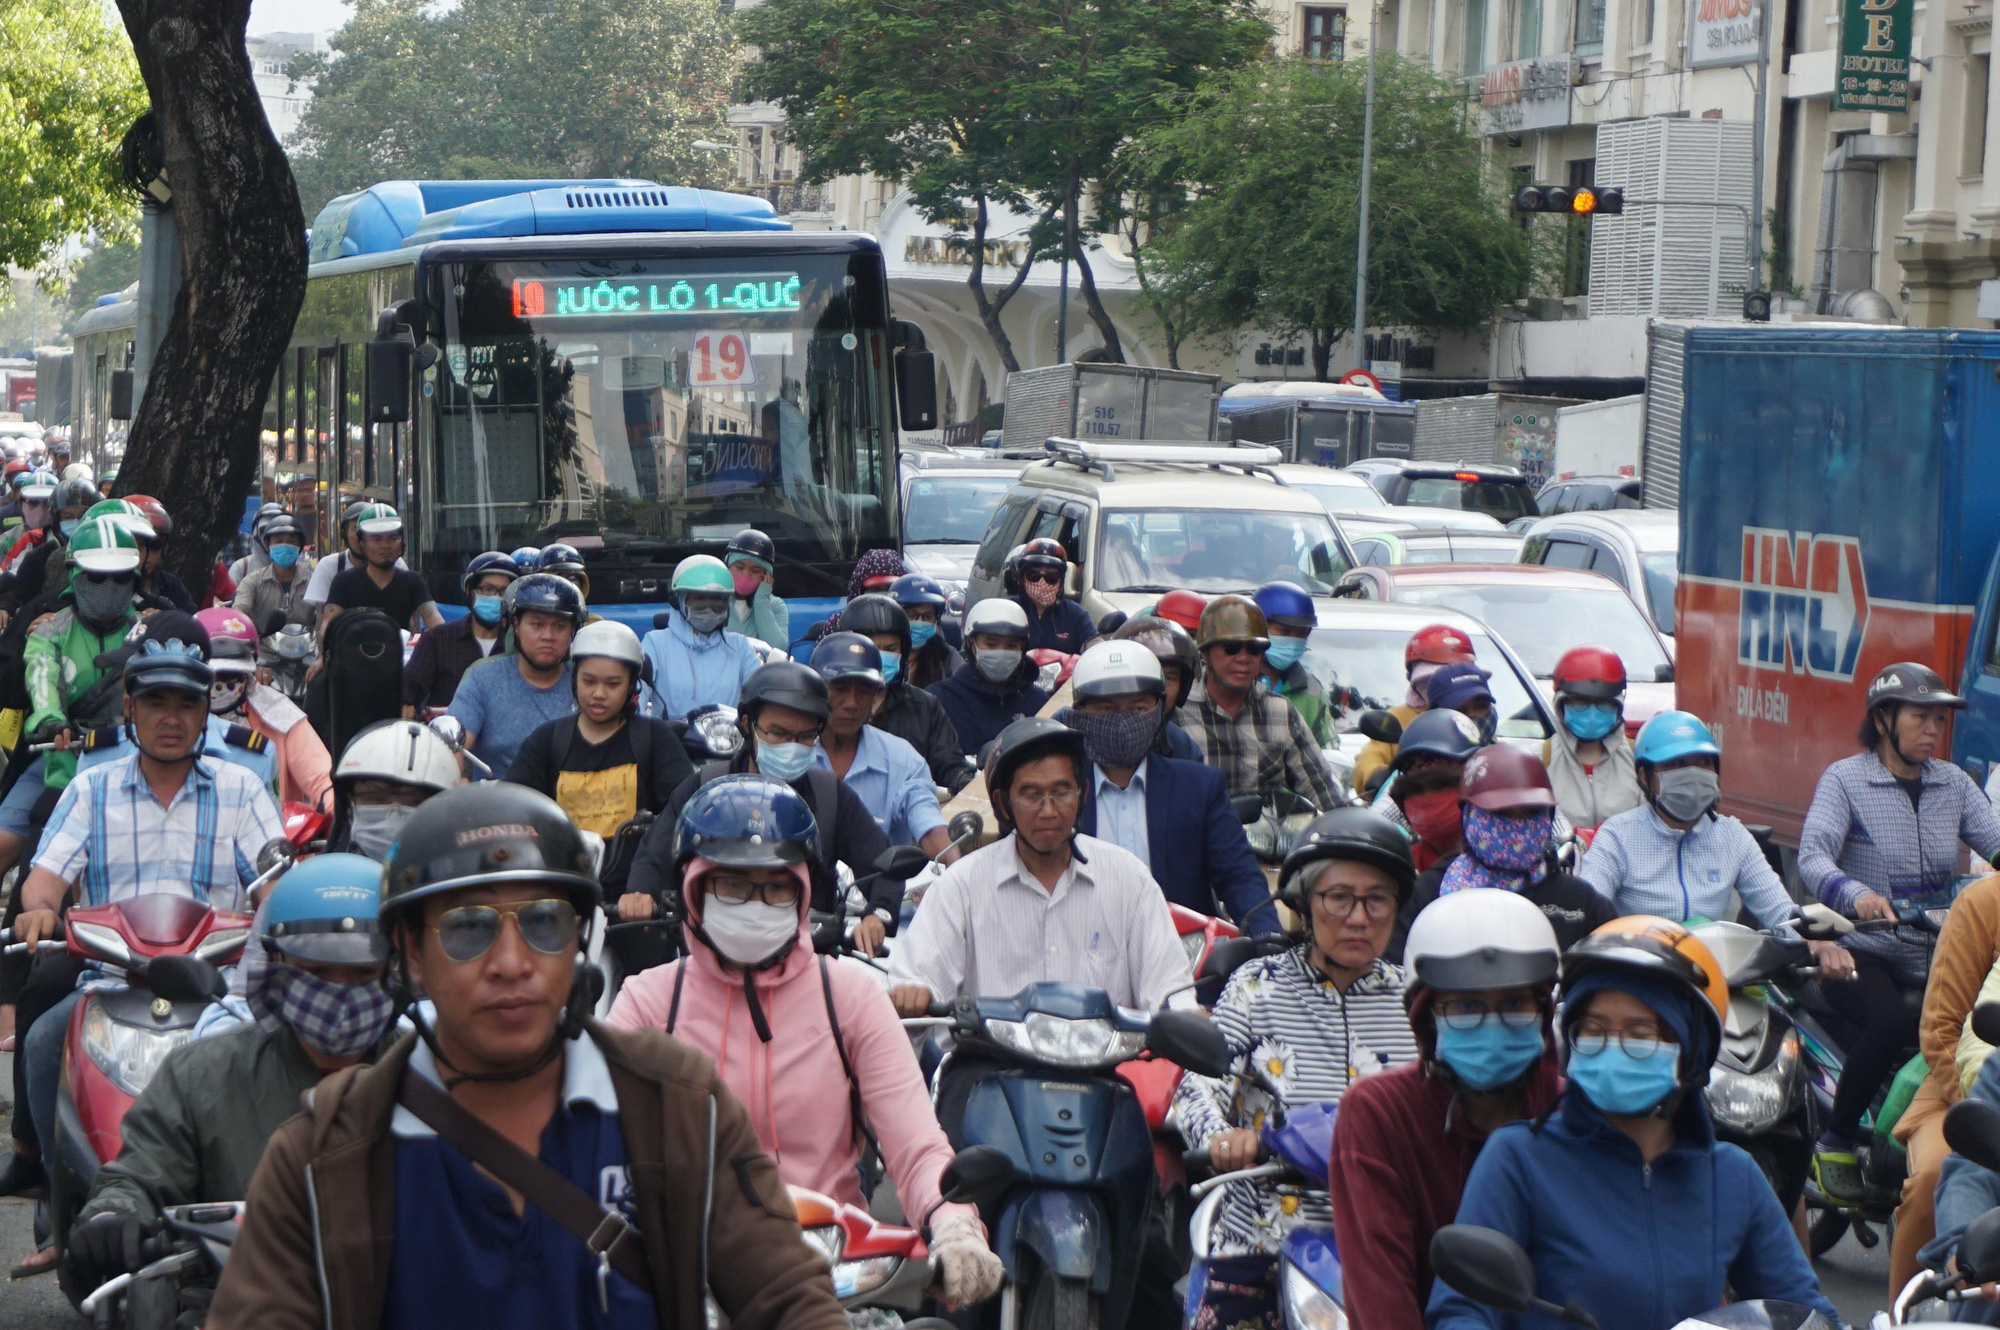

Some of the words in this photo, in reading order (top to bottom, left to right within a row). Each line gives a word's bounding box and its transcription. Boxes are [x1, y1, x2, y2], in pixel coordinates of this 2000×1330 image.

[1842, 55, 1908, 73] HOTEL
[512, 281, 544, 315] 19
[695, 335, 746, 381] 19
[1094, 406, 1115, 419] 51C
[1521, 459, 1543, 473] 54T
[1764, 679, 1788, 724] ĐẾN
[456, 823, 540, 847] HONDA
[748, 819, 765, 830] PNJ
